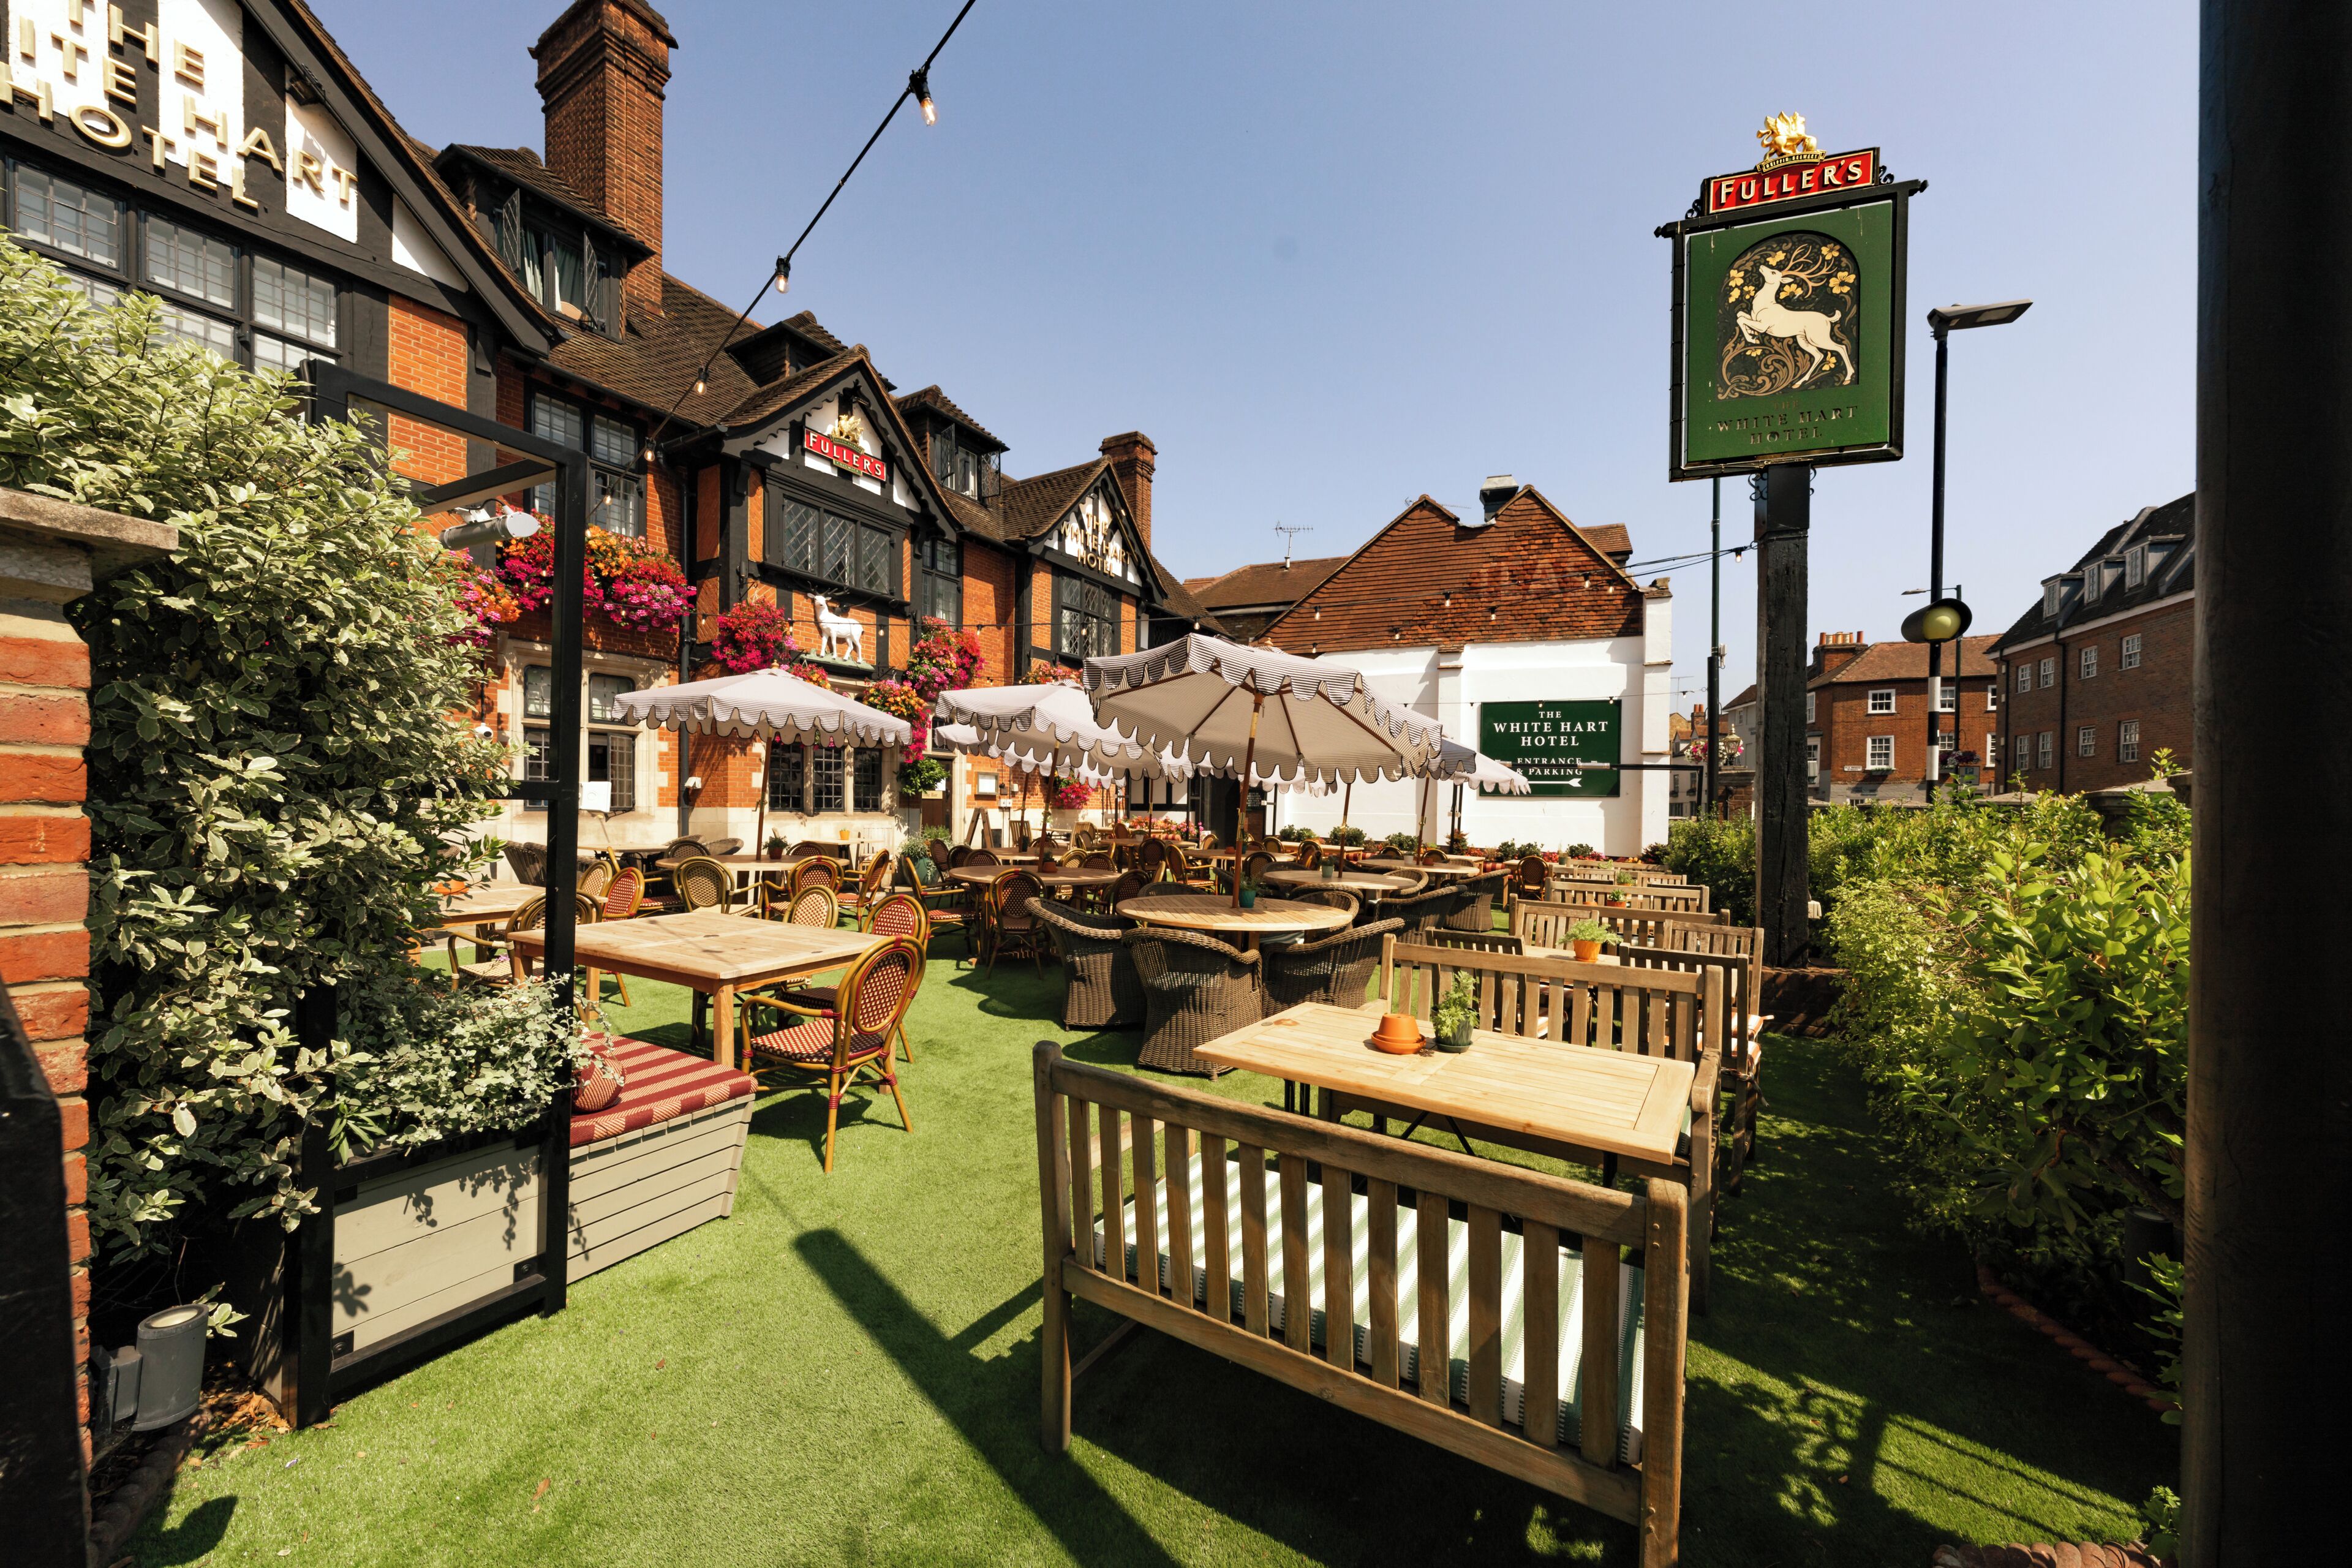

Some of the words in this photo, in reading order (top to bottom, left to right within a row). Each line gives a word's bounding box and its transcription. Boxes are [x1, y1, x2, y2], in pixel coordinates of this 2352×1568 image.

[0, 62, 258, 209] HOTEL
[184, 94, 358, 203] HART
[1721, 159, 1863, 205] FULLER'S
[1717, 413, 1788, 431] WHITE
[1799, 405, 1858, 423] HART
[1750, 426, 1822, 445] HOTEL
[809, 432, 882, 476] FULLER'S
[1086, 512, 1108, 536] THE
[1061, 521, 1098, 551] WHITE
[1102, 540, 1130, 565] HART
[1078, 548, 1115, 578] HOTEL
[1493, 722, 1553, 733] WHITE
[1560, 721, 1608, 733] HART
[1521, 736, 1580, 747] HOTEL
